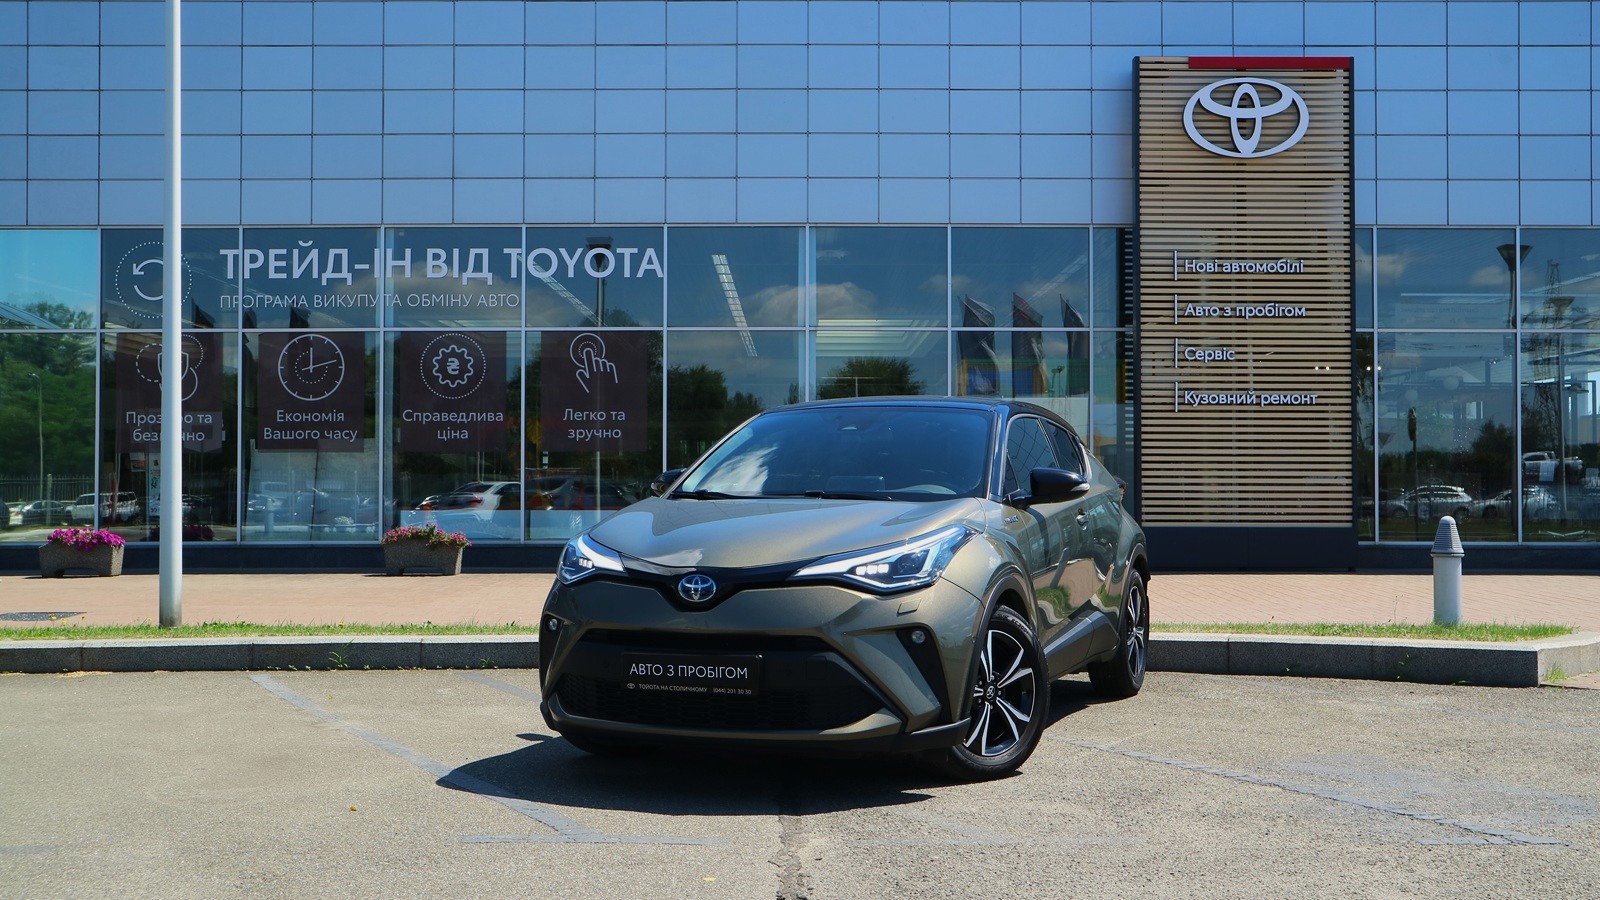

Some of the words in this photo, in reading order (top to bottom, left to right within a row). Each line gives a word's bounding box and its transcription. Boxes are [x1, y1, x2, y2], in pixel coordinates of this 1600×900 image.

[220, 240, 411, 285] ТРЕЙД-ІН
[427, 247, 493, 285] ВІД
[503, 247, 664, 278] TOYOTA
[1184, 259, 1219, 273] Нові
[1223, 259, 1304, 273] автомобілі
[220, 294, 308, 308] ПРОГРАМА
[314, 294, 380, 308] ВИКУПУ
[384, 293, 402, 307] ТА
[407, 293, 472, 307] ОБМІНУ
[477, 293, 520, 307] АВТО
[1184, 303, 1220, 317] Авто
[1223, 305, 1232, 317] з
[1236, 303, 1306, 319] пробігом
[1184, 347, 1235, 363] Сервіс
[1184, 388, 1256, 406] Кузовний
[1261, 392, 1318, 407] ремонт
[126, 411, 193, 426] Прозо
[197, 414, 212, 423] та
[276, 409, 345, 422] Економія
[402, 410, 504, 424] Справедлива
[562, 409, 607, 421] Легко
[610, 411, 626, 421] та
[132, 428, 205, 441] безно
[263, 428, 320, 440] Вашого
[324, 430, 358, 442] часу
[437, 427, 469, 441] ціна
[567, 428, 622, 441] зручно
[629, 663, 663, 676] АВТО
[678, 665, 748, 679] ПРОБІГОМ
